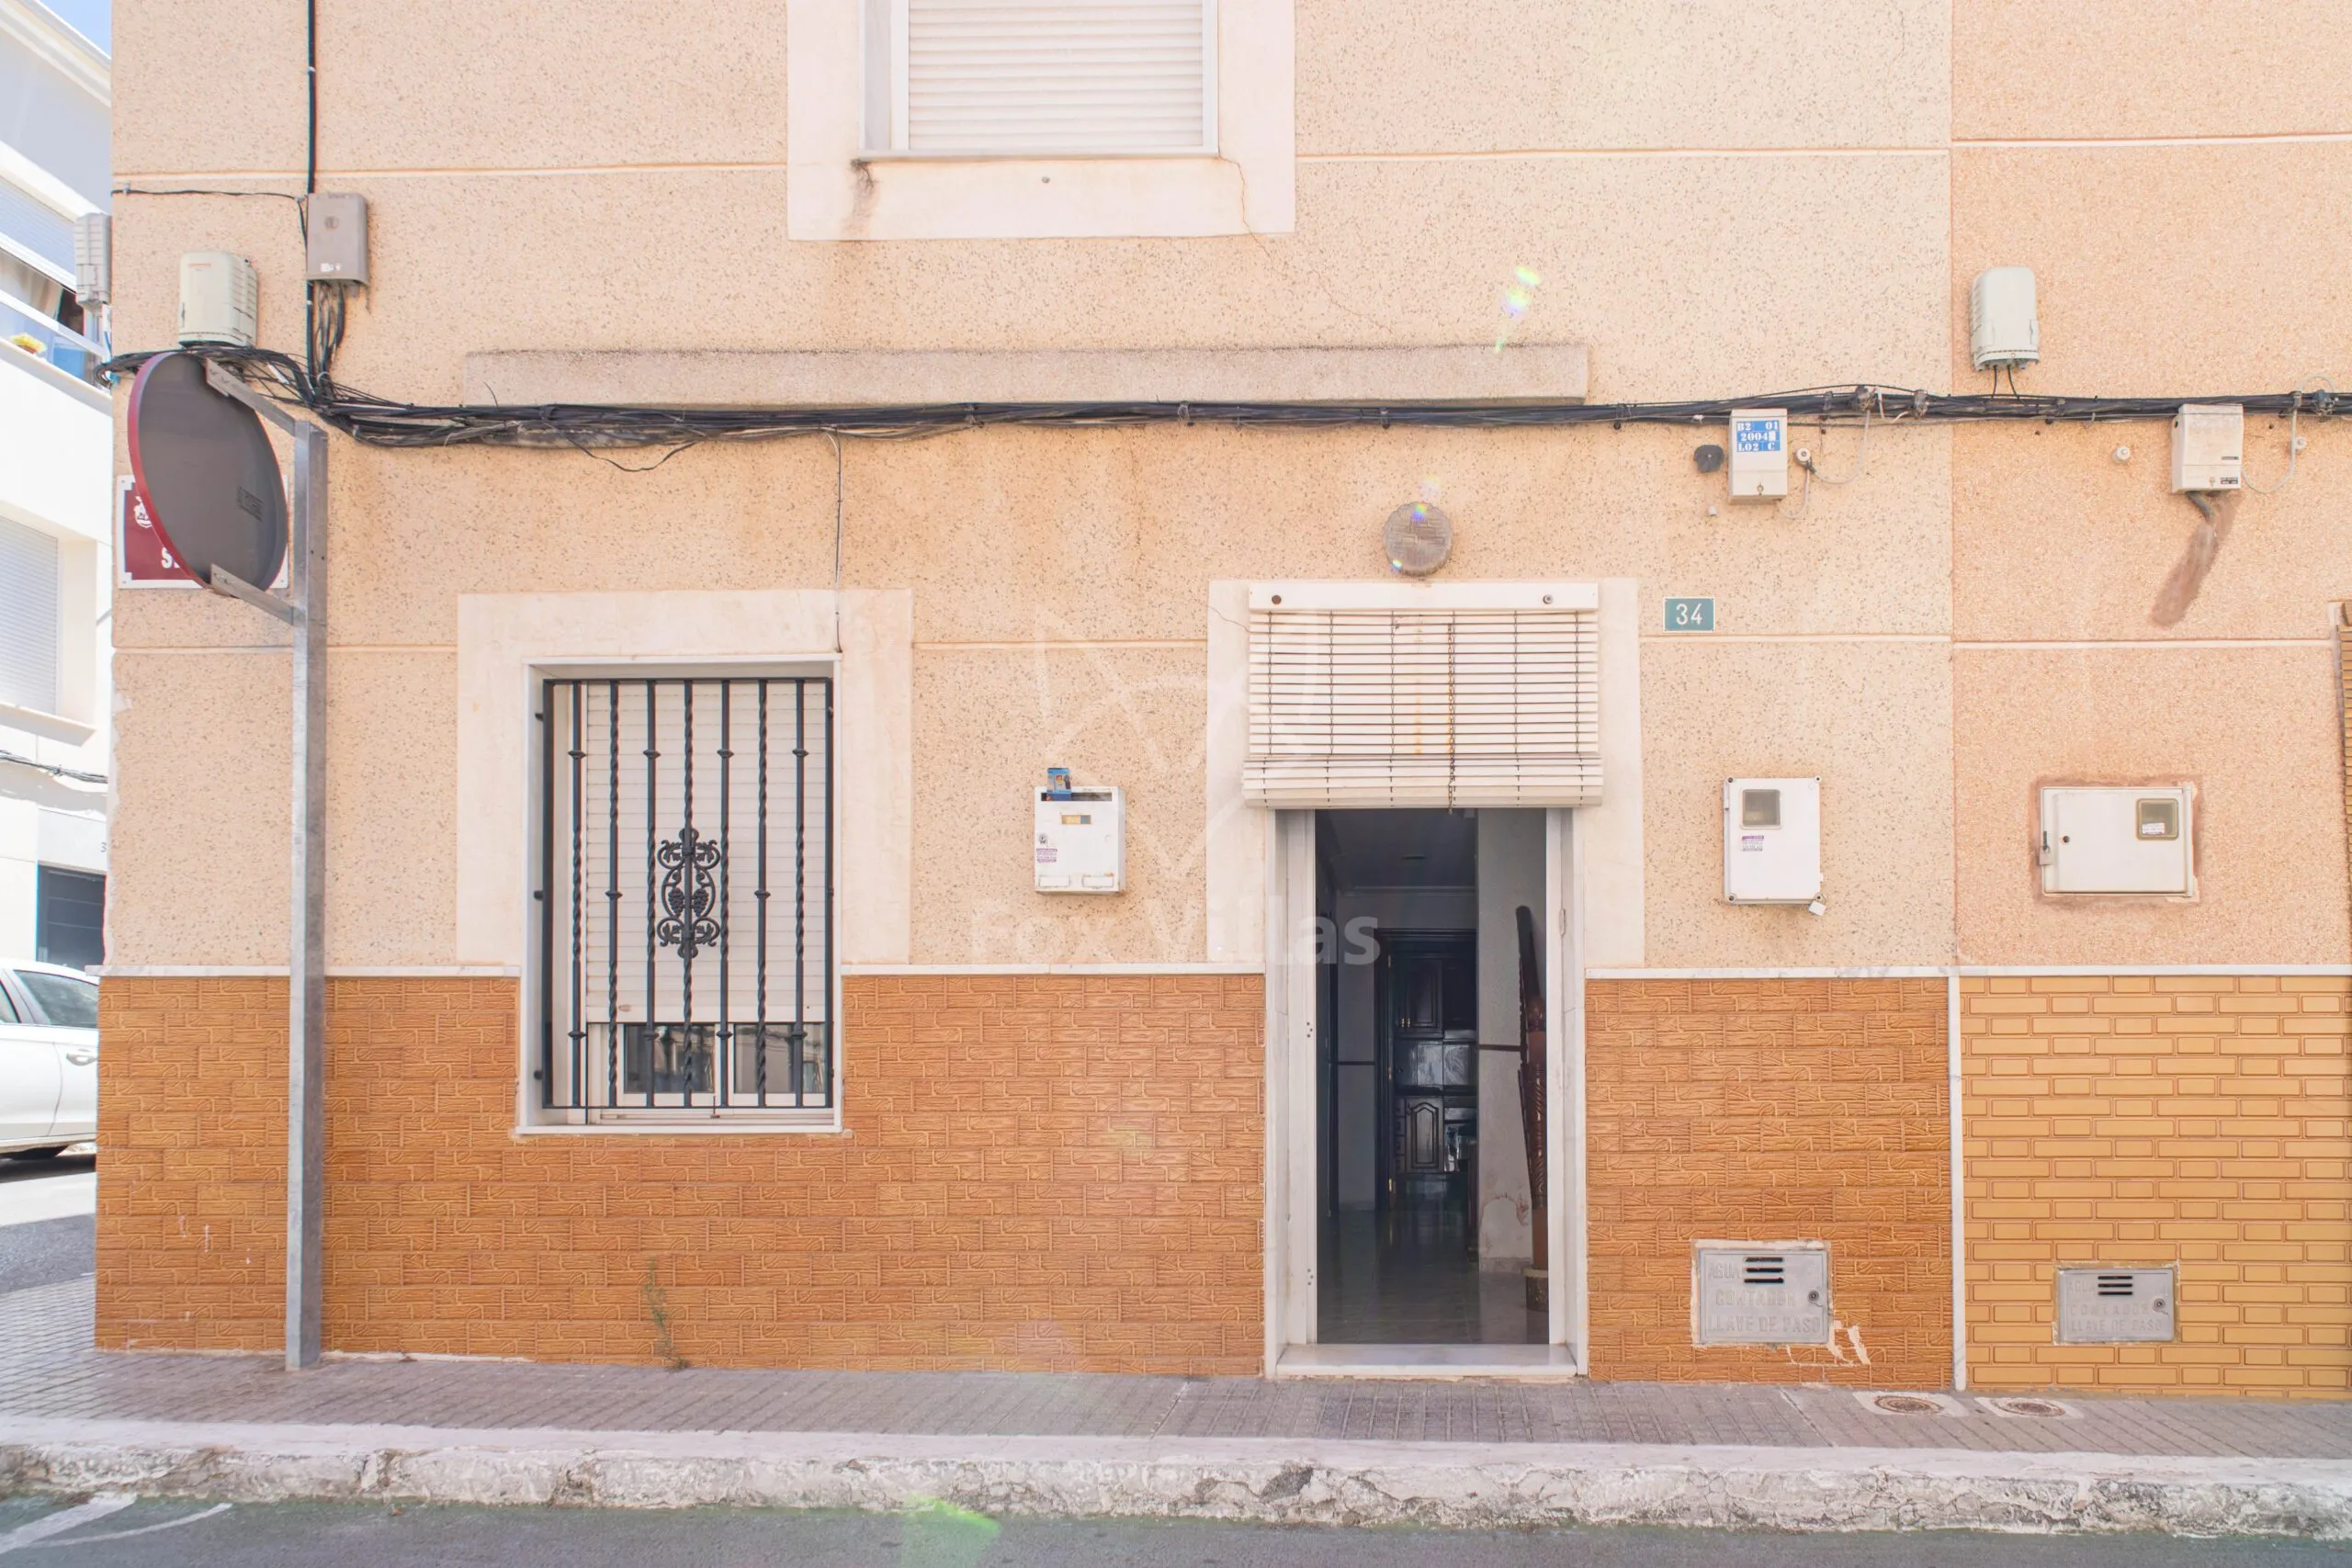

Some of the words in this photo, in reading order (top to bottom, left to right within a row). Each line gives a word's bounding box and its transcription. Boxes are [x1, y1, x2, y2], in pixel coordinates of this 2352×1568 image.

[1676, 603, 1702, 625] 34
[1715, 1289, 1796, 1307] CONTADOR
[1707, 1314, 1754, 1333] LLAVE
[1758, 1315, 1778, 1333] DE
[1782, 1316, 1821, 1334] PASO
